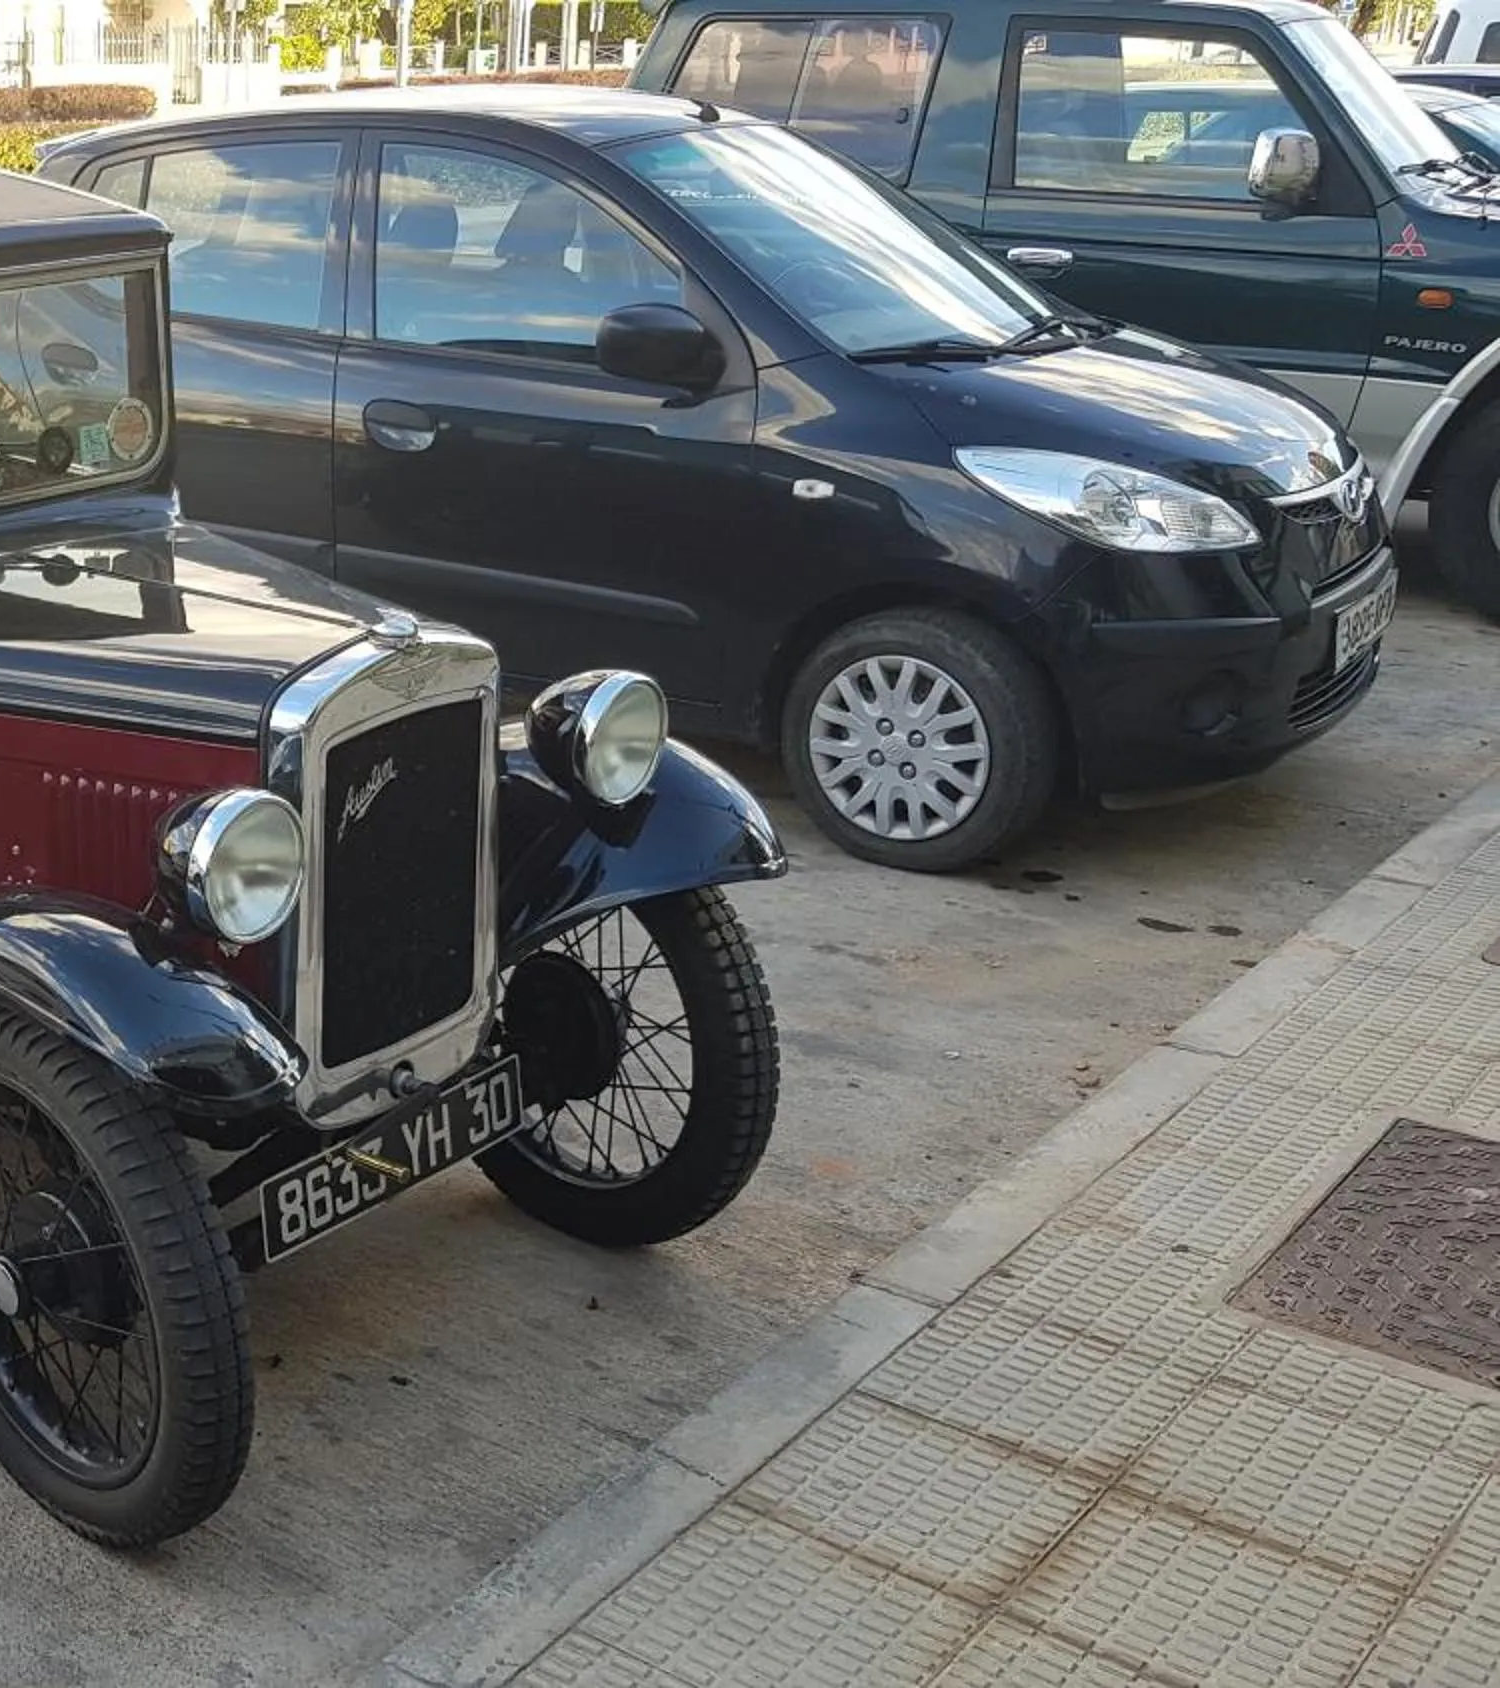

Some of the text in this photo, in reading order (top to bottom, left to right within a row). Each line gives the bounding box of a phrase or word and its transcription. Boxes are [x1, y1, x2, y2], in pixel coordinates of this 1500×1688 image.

[1384, 335, 1468, 354] PAJERO
[337, 757, 400, 843] Austin
[401, 1103, 451, 1177] YH
[465, 1071, 513, 1145] 30
